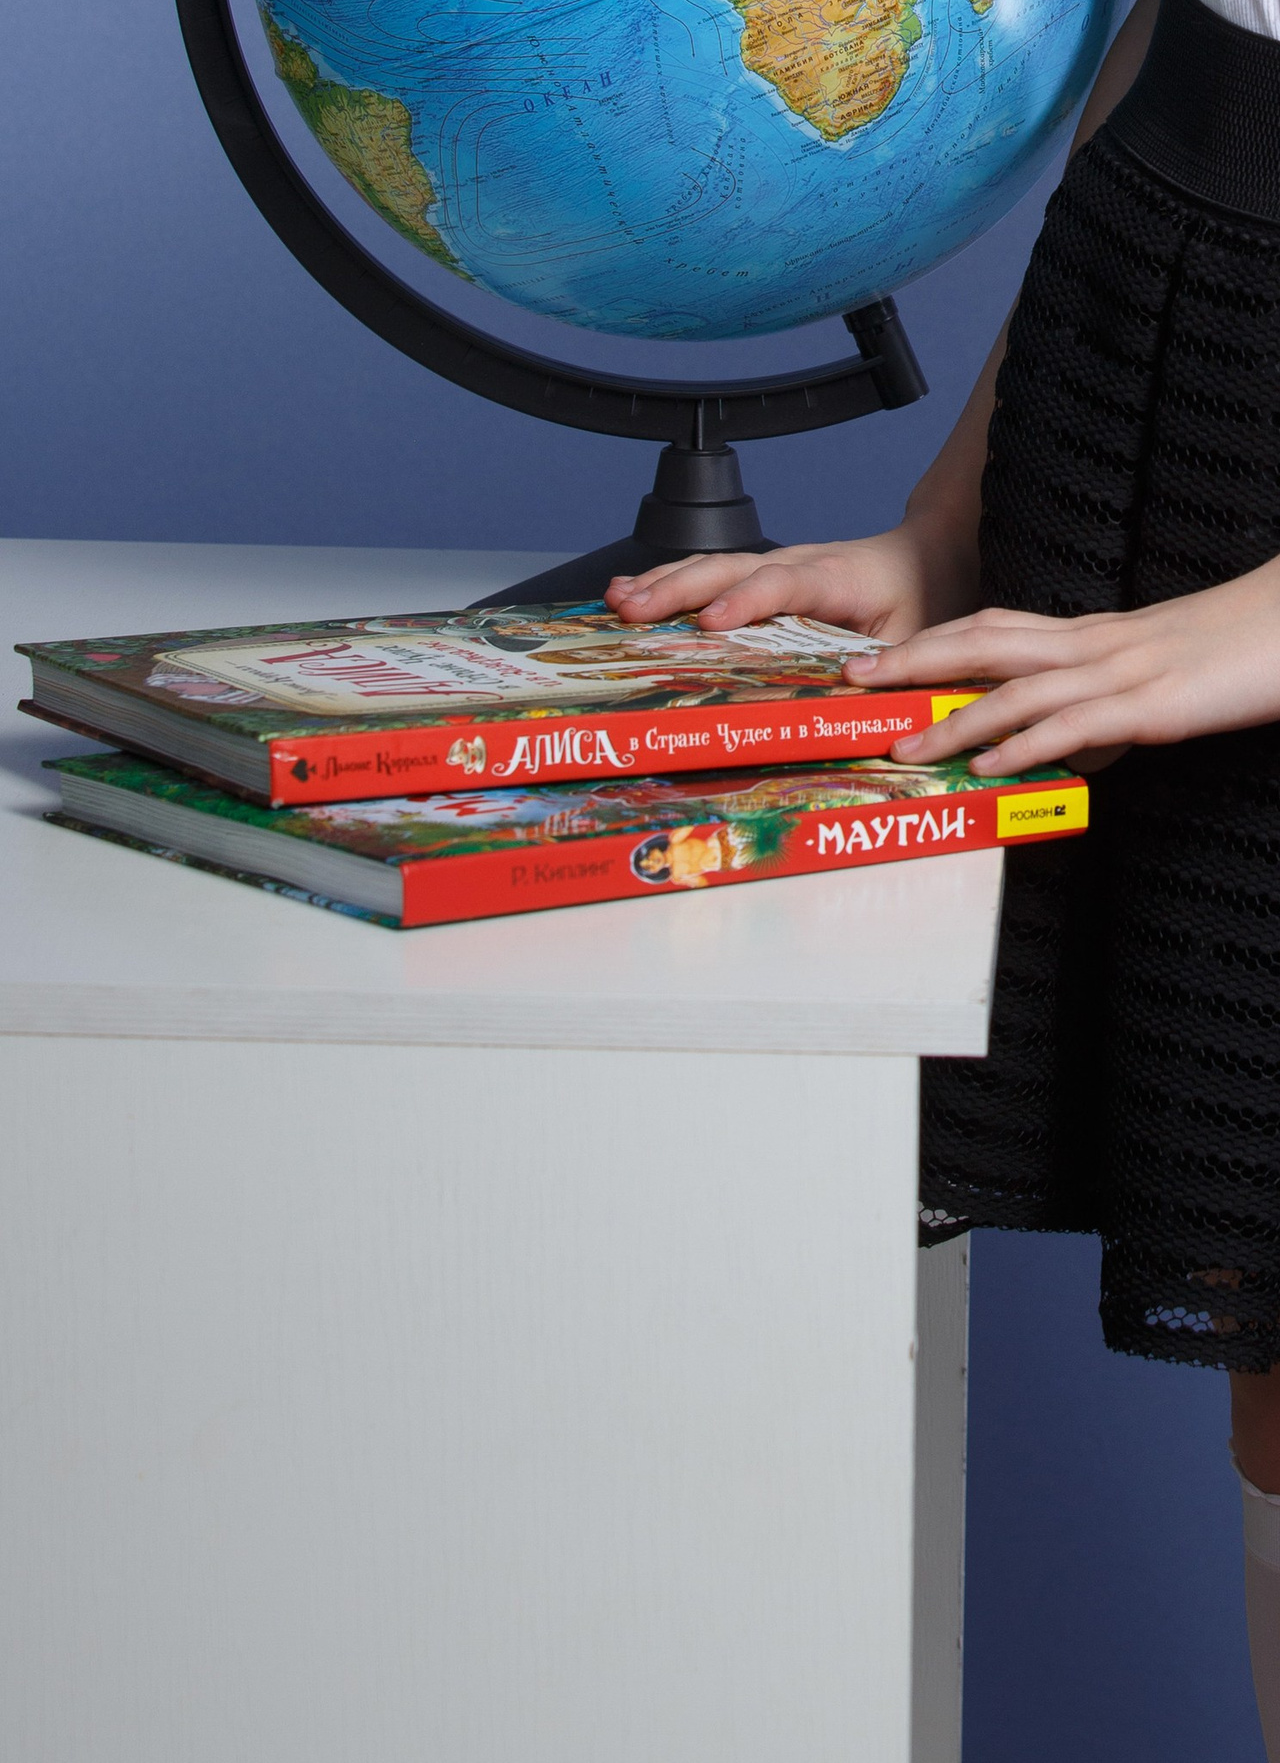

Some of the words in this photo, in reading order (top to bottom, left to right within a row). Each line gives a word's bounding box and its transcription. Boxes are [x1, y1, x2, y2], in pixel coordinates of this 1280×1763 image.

[747, 12, 804, 40] АНГОЛА
[824, 41, 864, 62] БОТСВАНА
[773, 56, 814, 78] НАМИБИЯ
[523, 70, 613, 113] ОКЕАН
[836, 82, 870, 103] ЮЖНАЯ
[839, 101, 875, 121] АФРИКА
[664, 255, 750, 279] хребет
[258, 641, 505, 702] АЛИСА
[491, 727, 636, 777] АЛИСА
[629, 737, 639, 751] в
[645, 726, 710, 755] Стране
[716, 723, 773, 753] Чудес
[779, 726, 791, 740] и
[798, 724, 808, 739] в
[813, 716, 913, 741] Зазеркалье
[1009, 806, 1053, 822] РОСМЭН
[817, 806, 966, 855] МАУГЛИ
